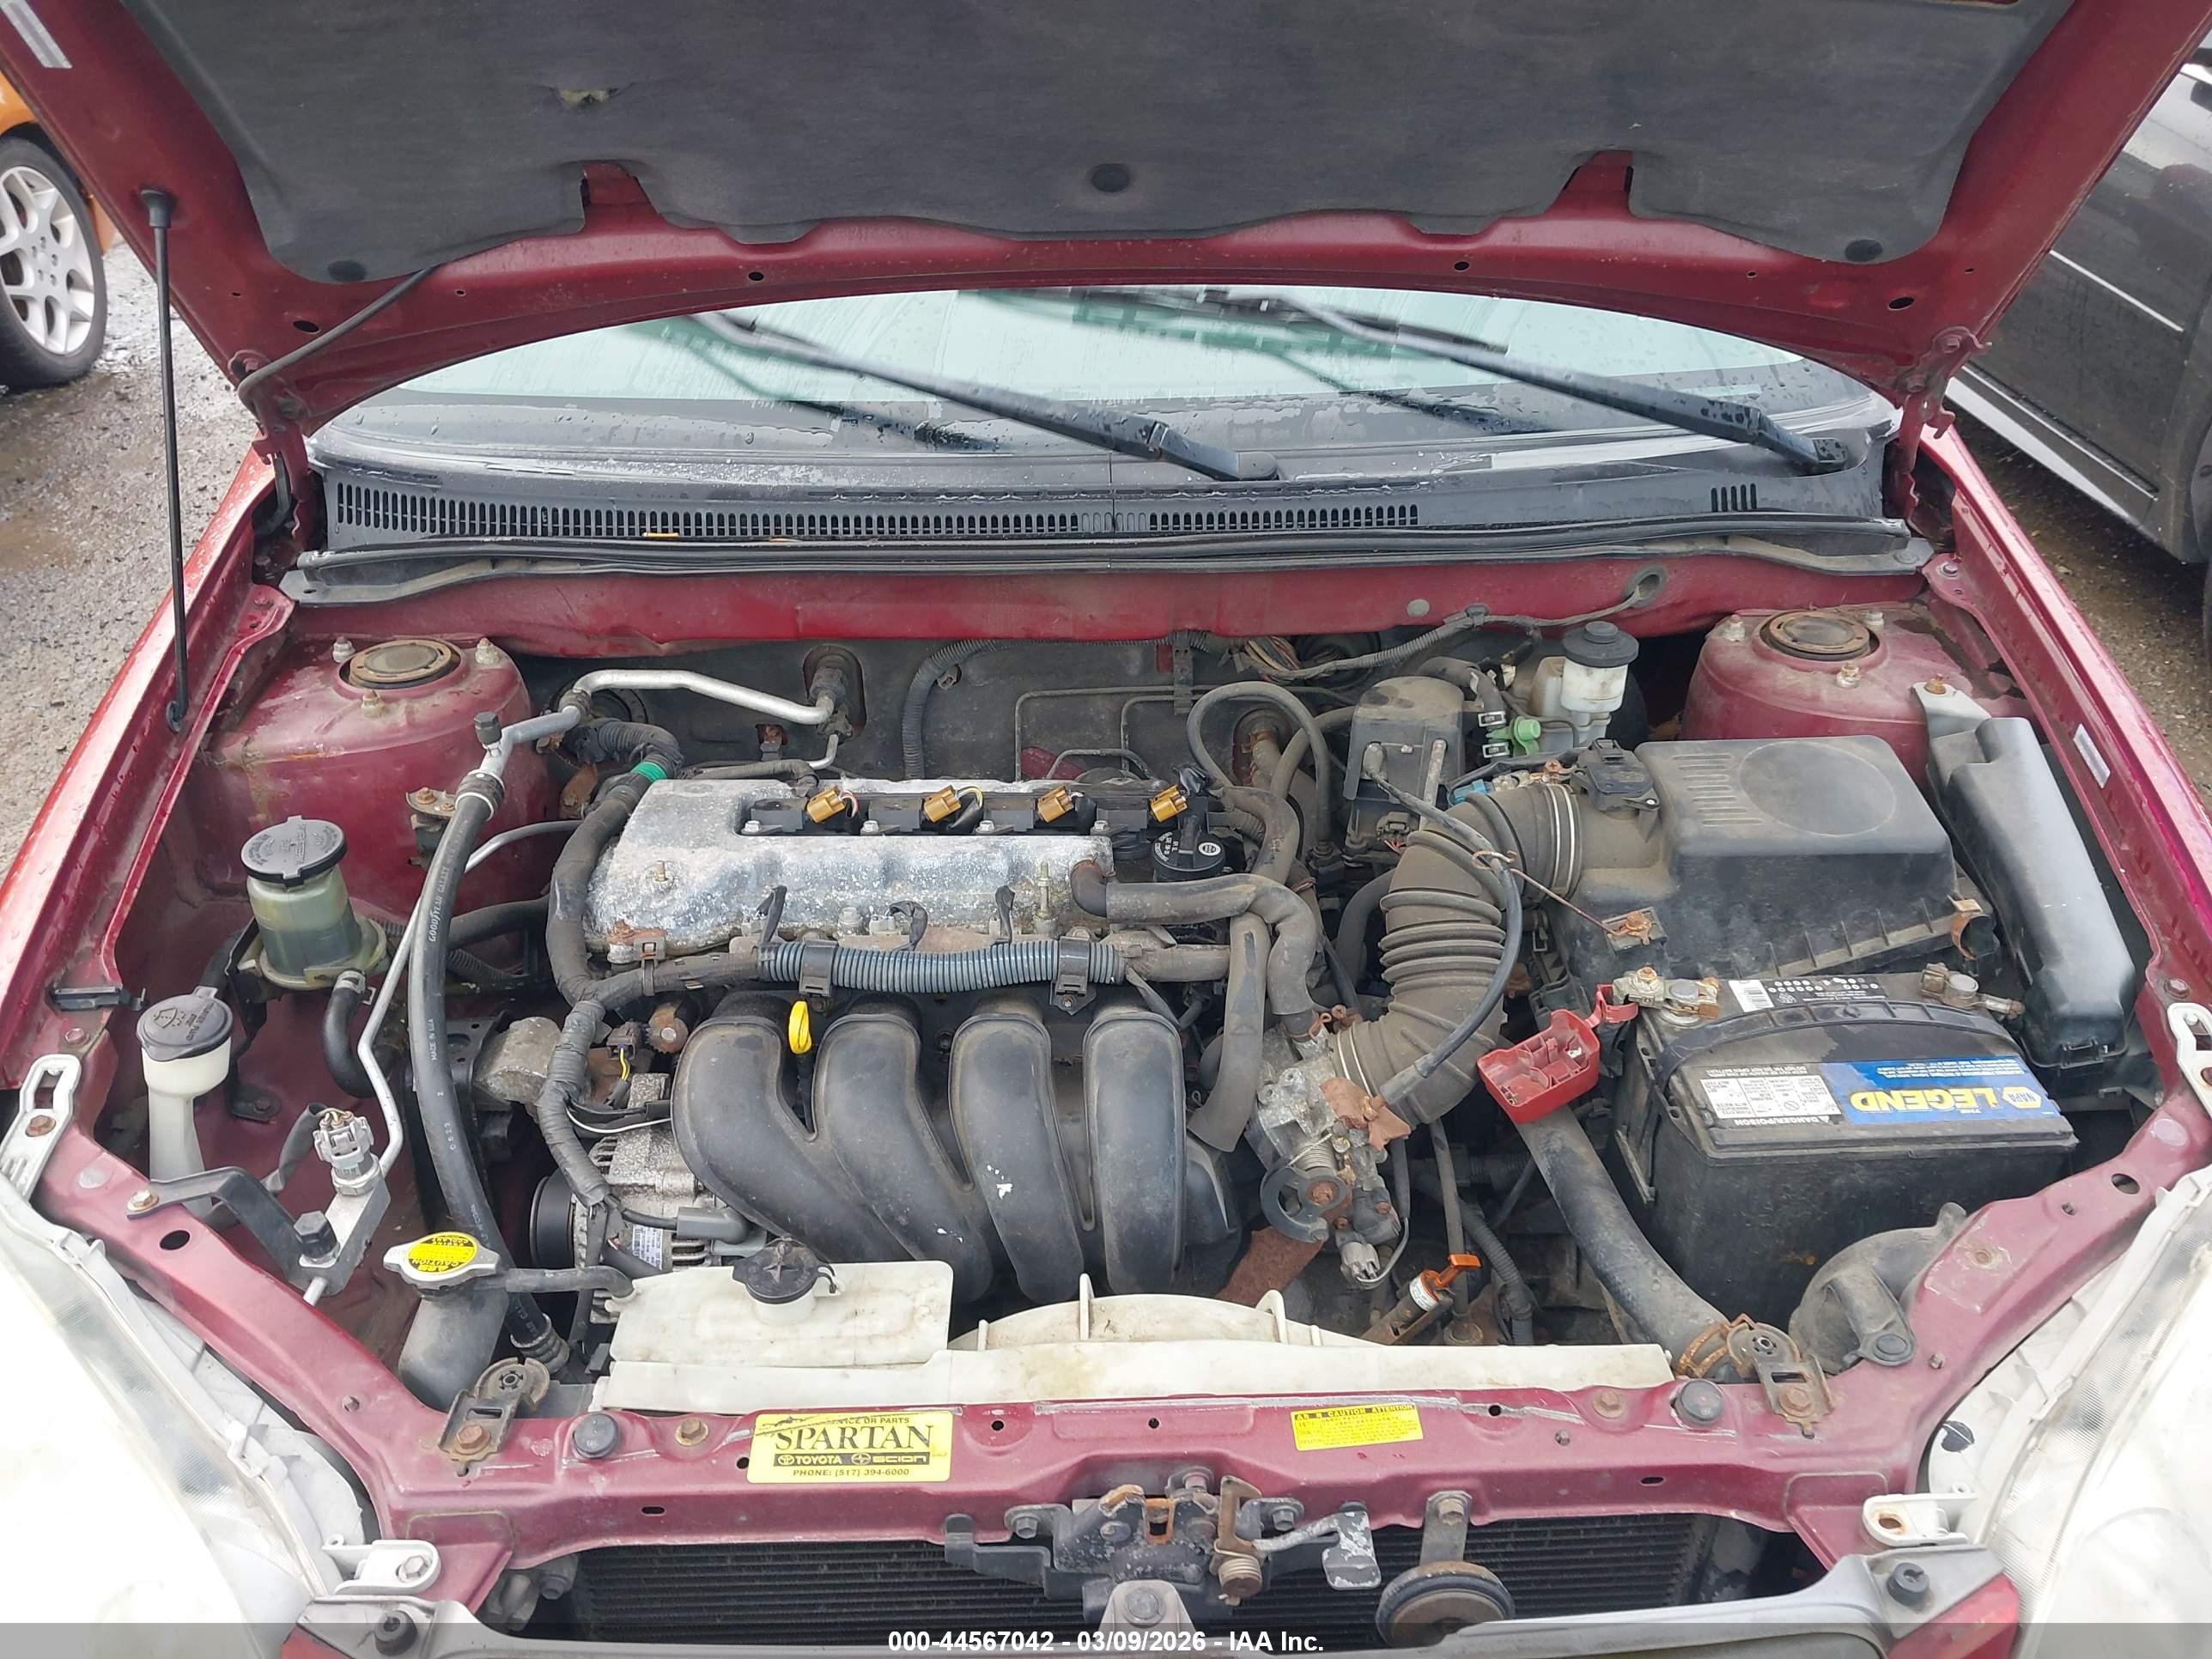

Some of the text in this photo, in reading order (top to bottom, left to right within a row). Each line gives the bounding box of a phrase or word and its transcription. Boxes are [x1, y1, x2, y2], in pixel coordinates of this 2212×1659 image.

[428, 866, 450, 942] GOODYEAR GALAXY
[1850, 1087, 1999, 1111] LEGEND
[2008, 1092, 2035, 1103] NAPA
[1328, 1404, 1413, 1419] CAUTION ATTENTION
[775, 1425, 933, 1450] SPARTAN
[795, 1455, 842, 1465] TOYOTA
